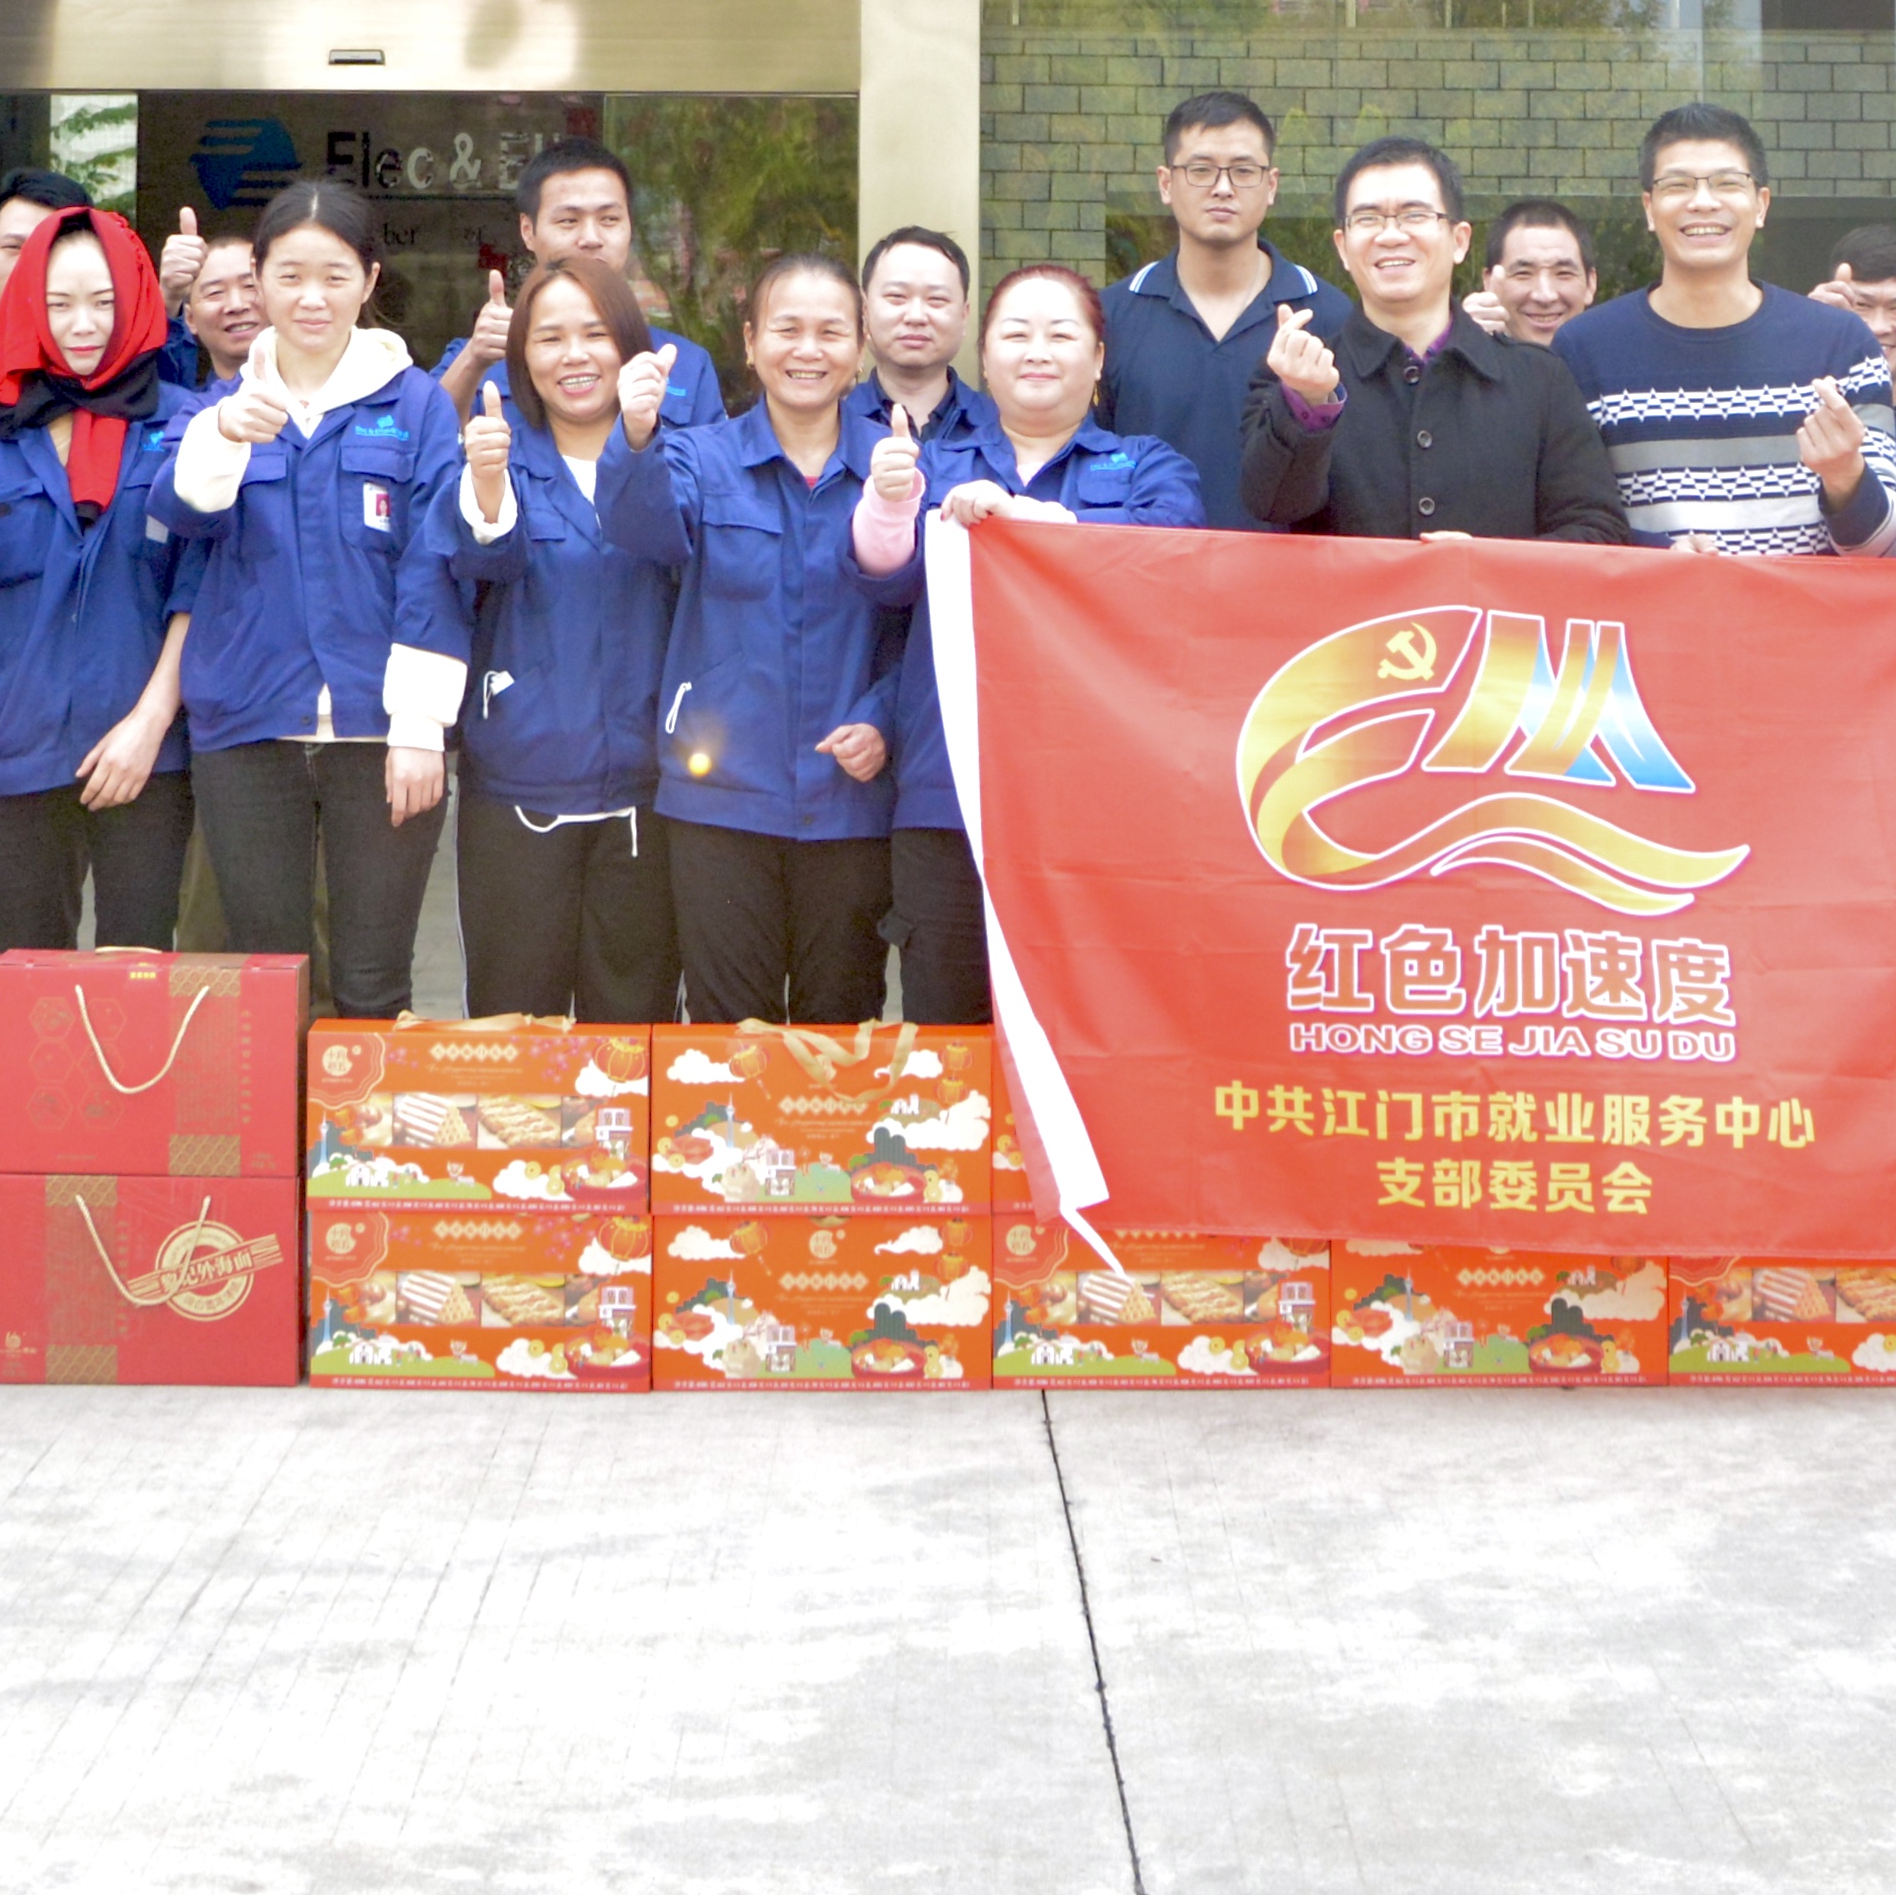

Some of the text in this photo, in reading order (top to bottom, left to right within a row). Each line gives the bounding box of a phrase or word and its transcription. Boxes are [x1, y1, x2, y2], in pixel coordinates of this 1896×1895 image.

[449, 132, 483, 189] &
[1286, 923, 1736, 1026] 红色加速度
[1290, 1023, 1736, 1062] HONG SE JIA SU DU
[1215, 1079, 1816, 1151] 中共江门市就业服务中心
[1376, 1156, 1653, 1215] 支部委员会
